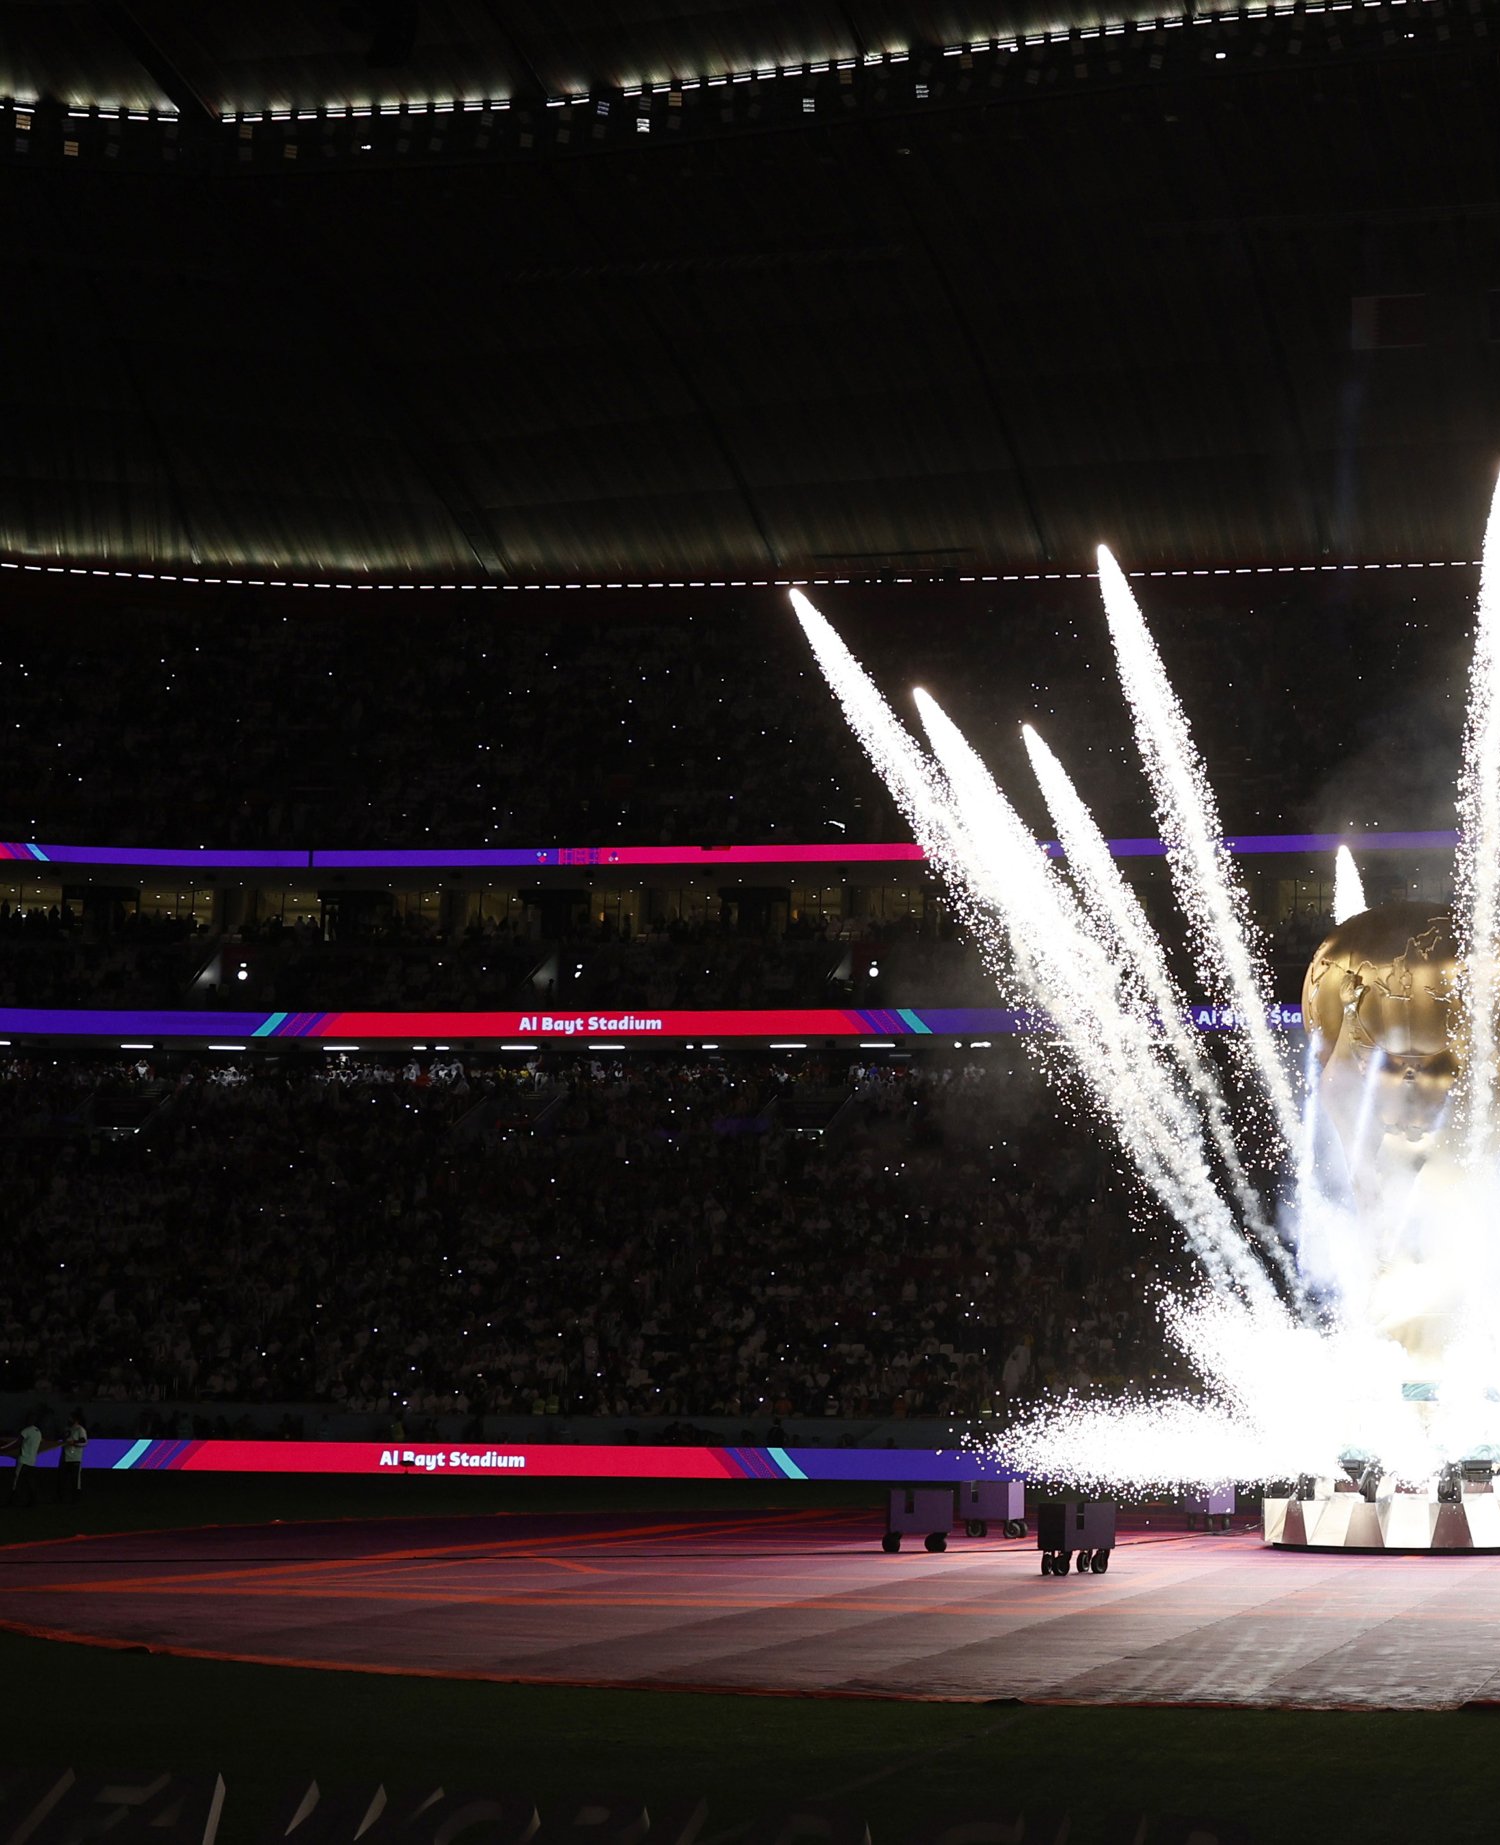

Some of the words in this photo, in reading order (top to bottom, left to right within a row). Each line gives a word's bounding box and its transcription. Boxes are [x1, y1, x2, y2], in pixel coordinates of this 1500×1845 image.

[519, 1017, 538, 1031] Al
[541, 1017, 584, 1035] Bayt
[588, 1016, 662, 1031] Stadium
[380, 1450, 399, 1466] Al
[449, 1451, 526, 1468] Stadium
